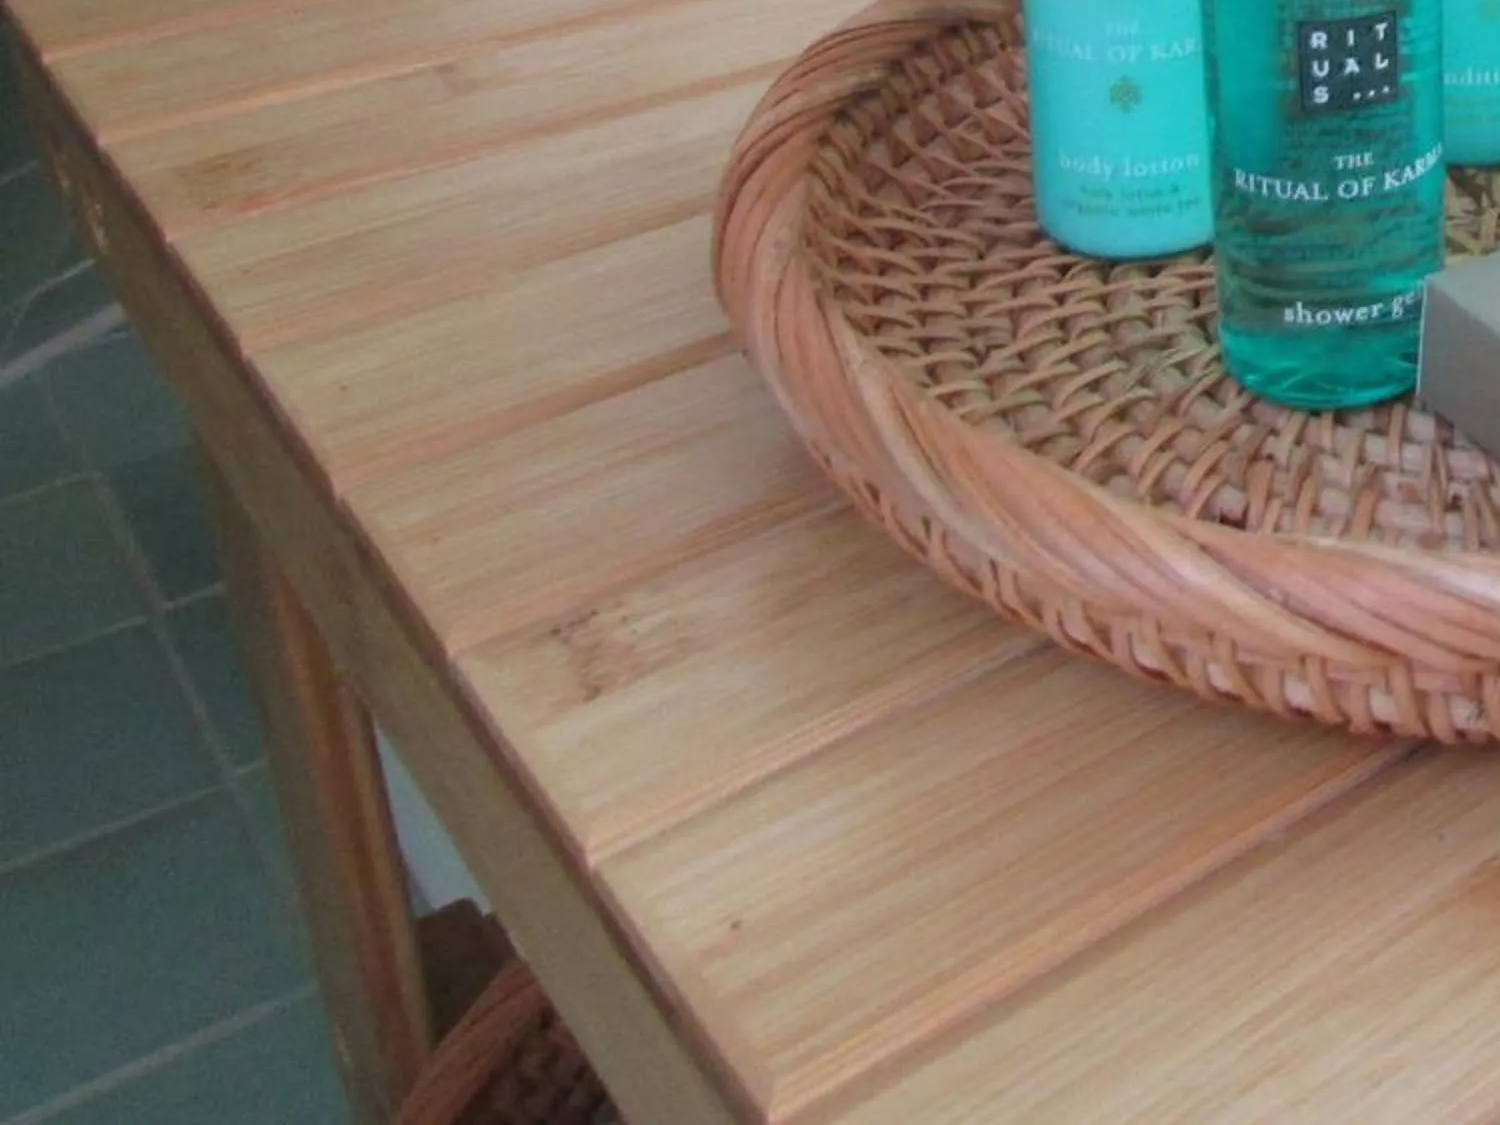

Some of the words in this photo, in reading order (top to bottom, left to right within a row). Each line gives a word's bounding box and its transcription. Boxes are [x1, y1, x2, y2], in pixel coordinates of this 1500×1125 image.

[1106, 43, 1143, 64] OF
[1058, 147, 1114, 182] body
[1122, 152, 1200, 178] lotion
[1333, 151, 1374, 170] THE
[1233, 168, 1329, 201] RITUAL
[1337, 176, 1378, 199] OF
[1283, 301, 1383, 326] shower
